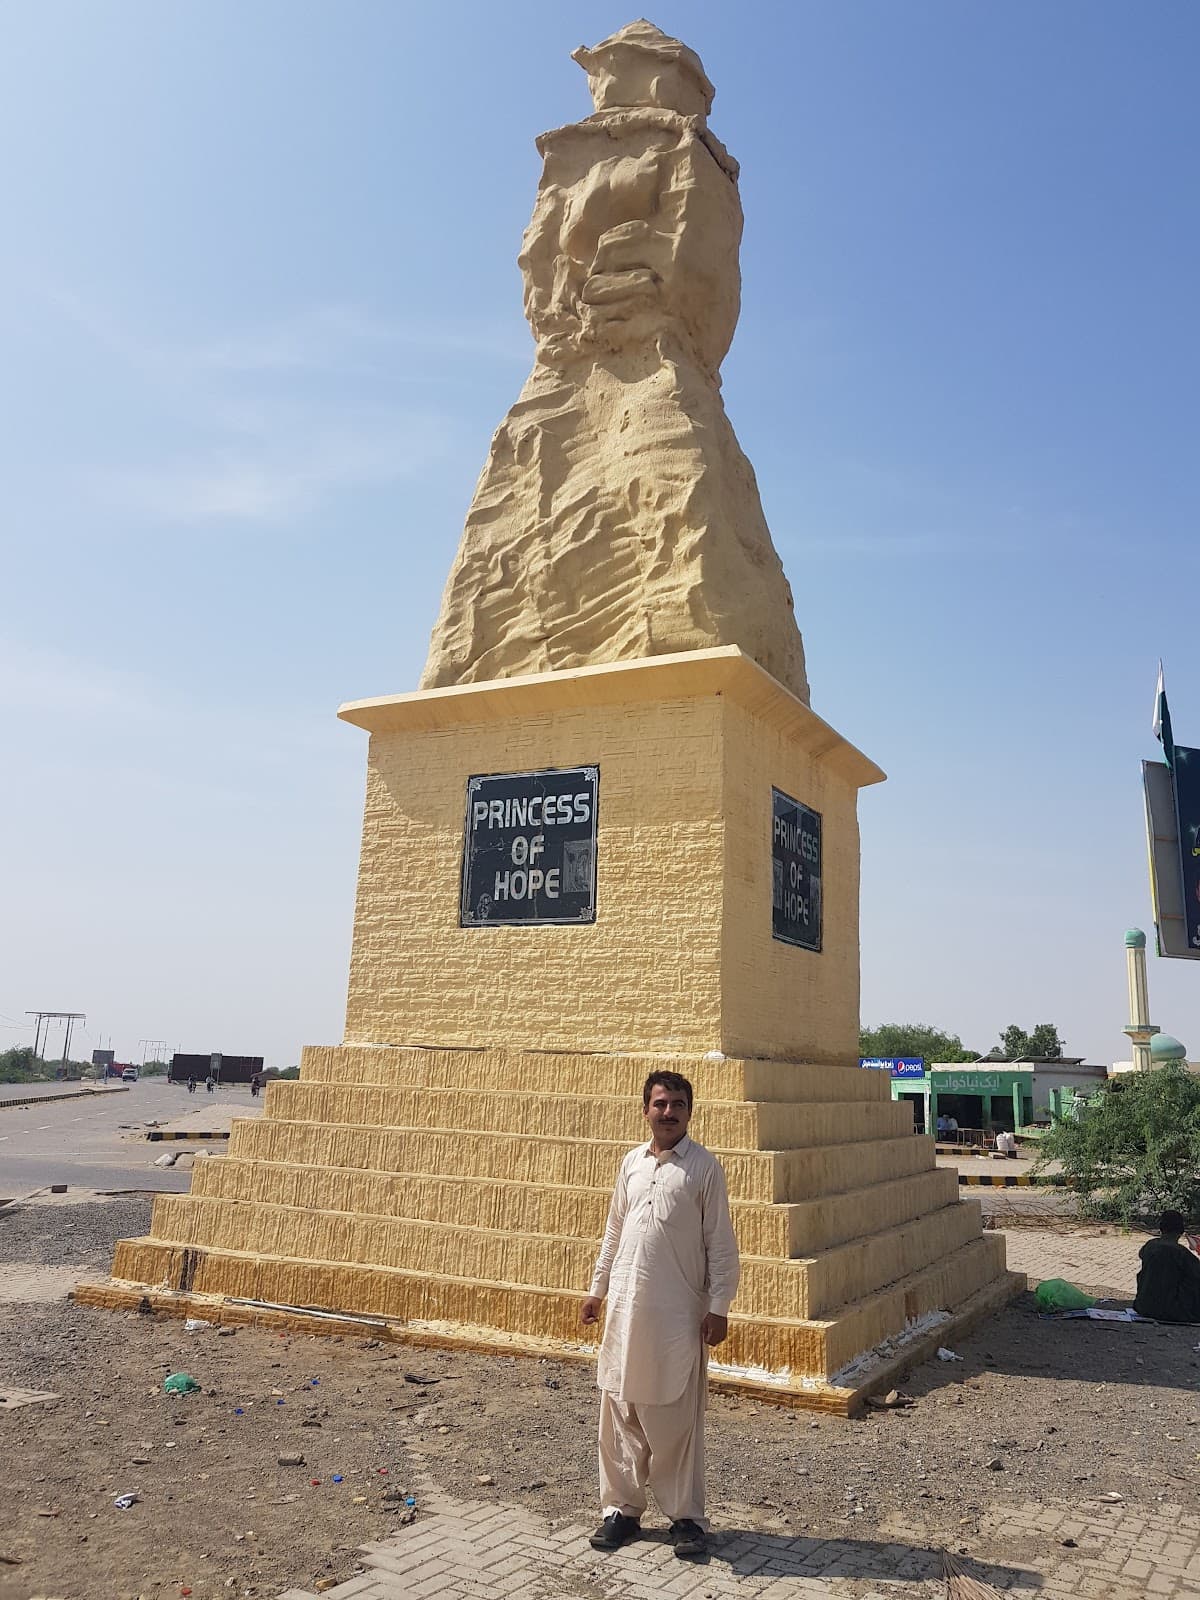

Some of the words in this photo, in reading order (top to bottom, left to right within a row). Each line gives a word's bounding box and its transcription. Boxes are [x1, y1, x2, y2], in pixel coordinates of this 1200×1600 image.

[472, 793, 590, 831] PRINCESS
[511, 834, 545, 866] OF
[774, 816, 819, 863] PRINCESS
[494, 868, 560, 901] HOPE
[790, 861, 803, 890] OF
[784, 893, 809, 926] HOPE
[905, 1062, 923, 1073] pepsi
